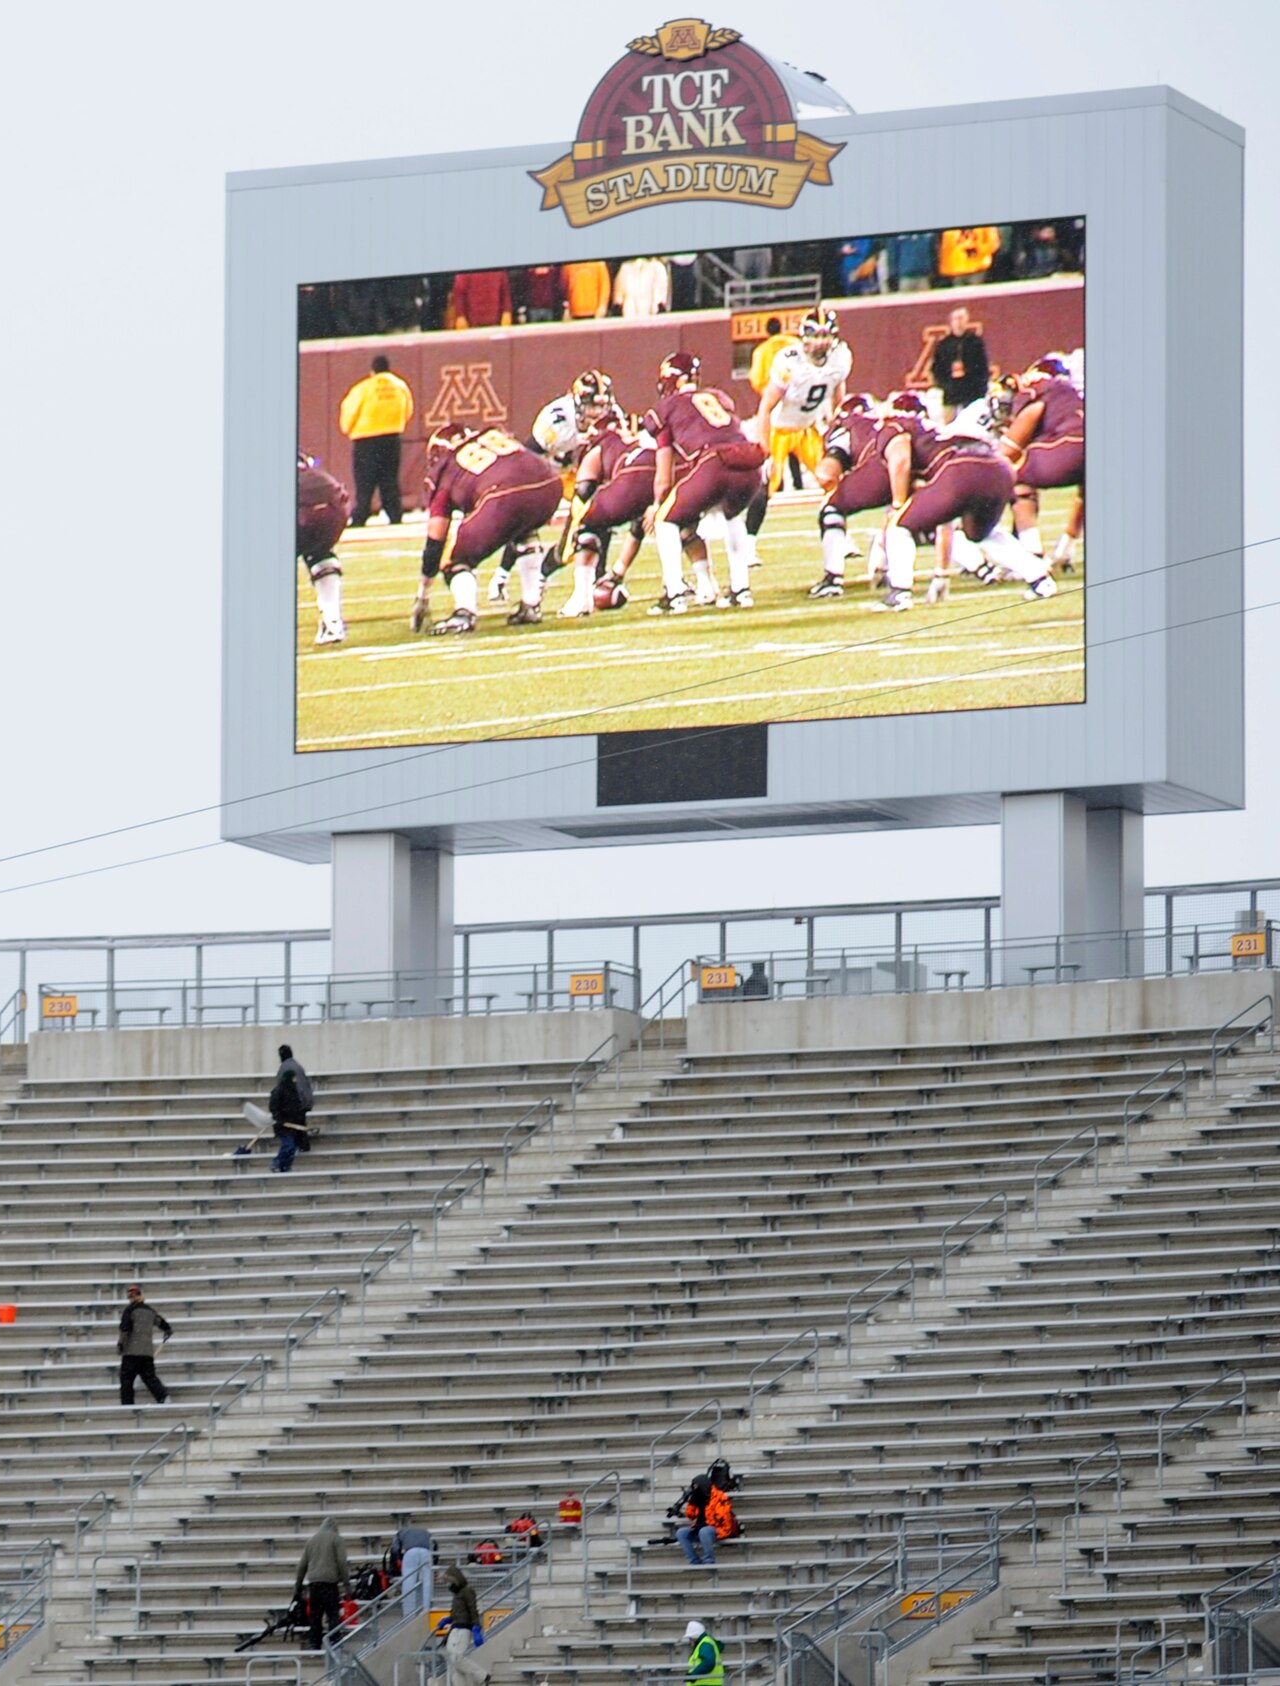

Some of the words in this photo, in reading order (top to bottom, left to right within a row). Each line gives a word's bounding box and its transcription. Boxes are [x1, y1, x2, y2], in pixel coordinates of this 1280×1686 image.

[666, 25, 701, 53] M
[642, 68, 729, 115] TCF
[621, 106, 747, 155] BANK
[585, 163, 778, 213] STADIUM
[425, 362, 507, 427] M
[800, 384, 827, 412] 9
[1236, 939, 1258, 951] 231
[575, 979, 598, 991] 230
[706, 972, 728, 985] 231
[48, 1001, 72, 1013] 230
